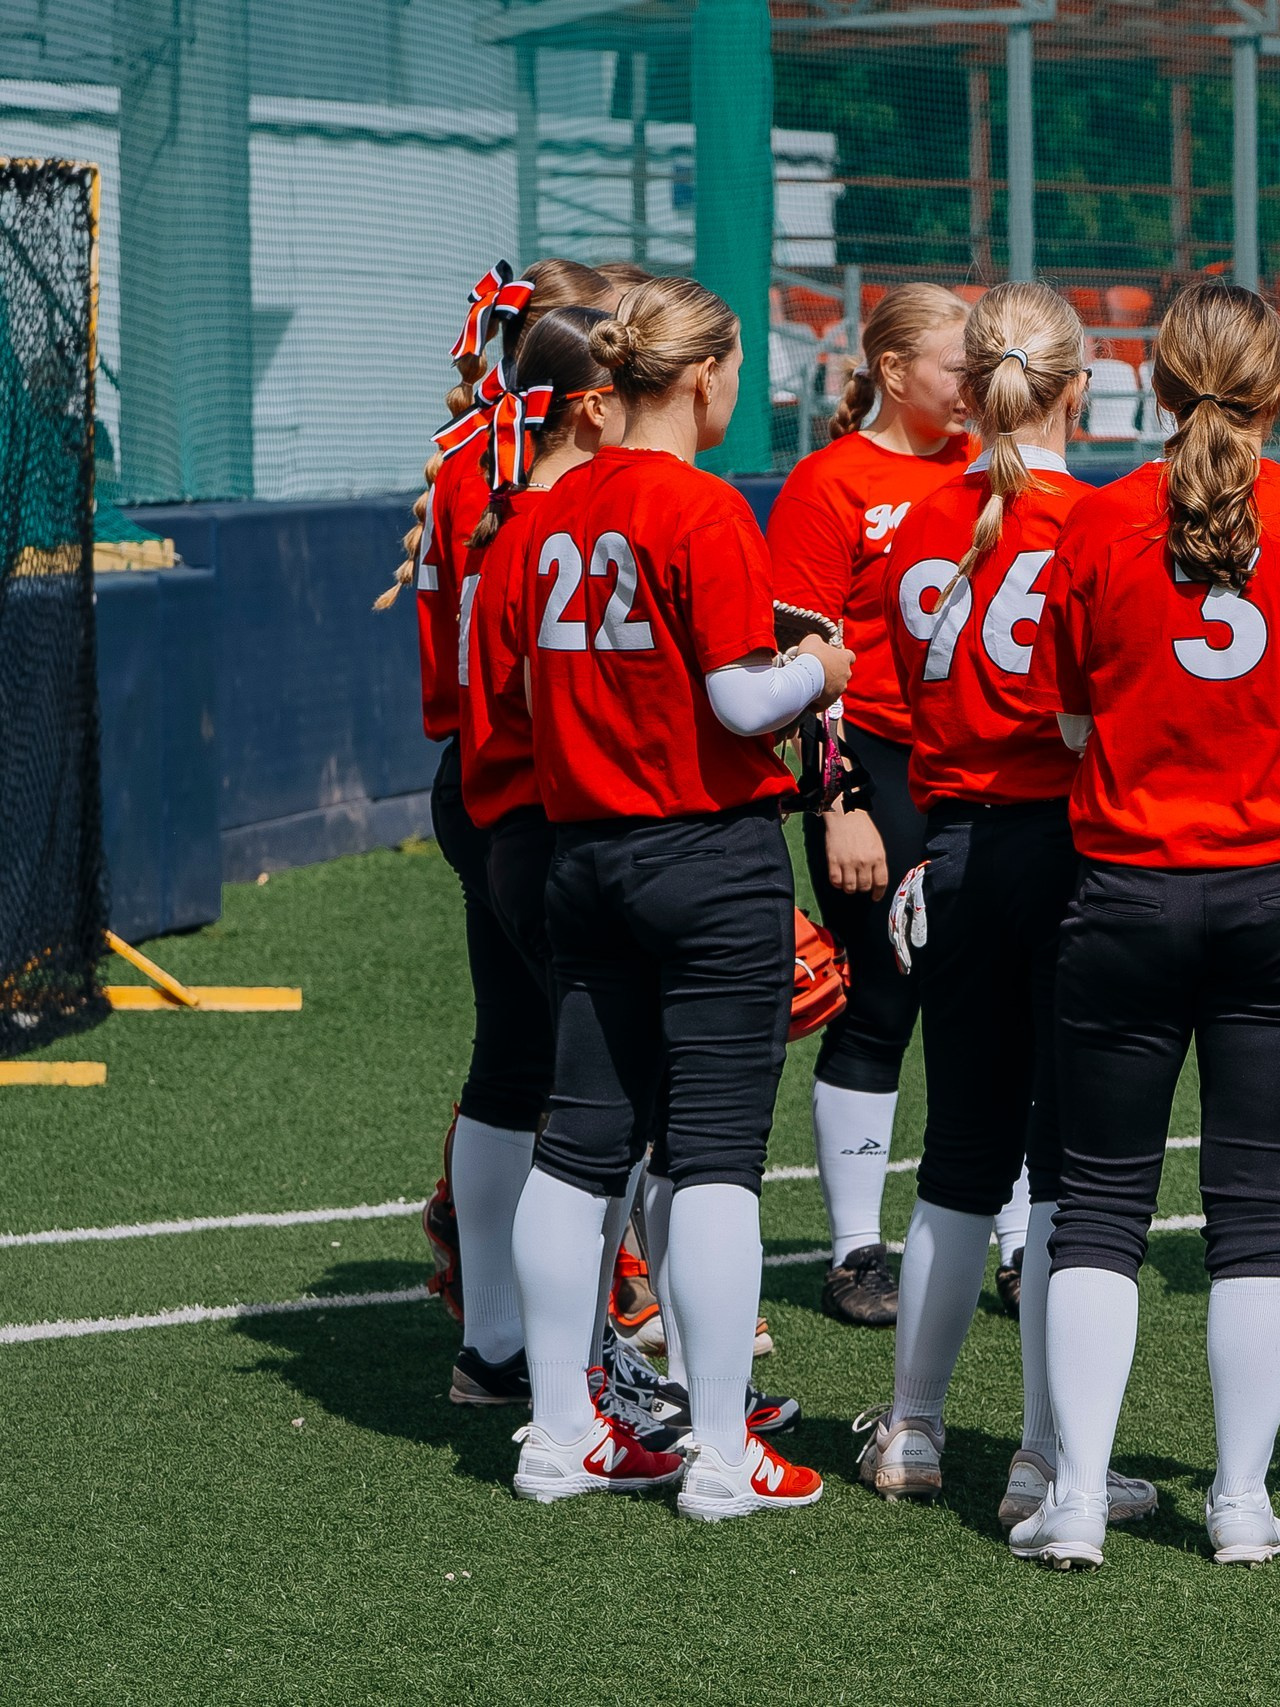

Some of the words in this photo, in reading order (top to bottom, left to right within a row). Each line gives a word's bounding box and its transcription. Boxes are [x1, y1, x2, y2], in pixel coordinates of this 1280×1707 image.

[537, 531, 656, 651] 22
[898, 550, 1054, 681] 96
[1172, 546, 1269, 681] 3
